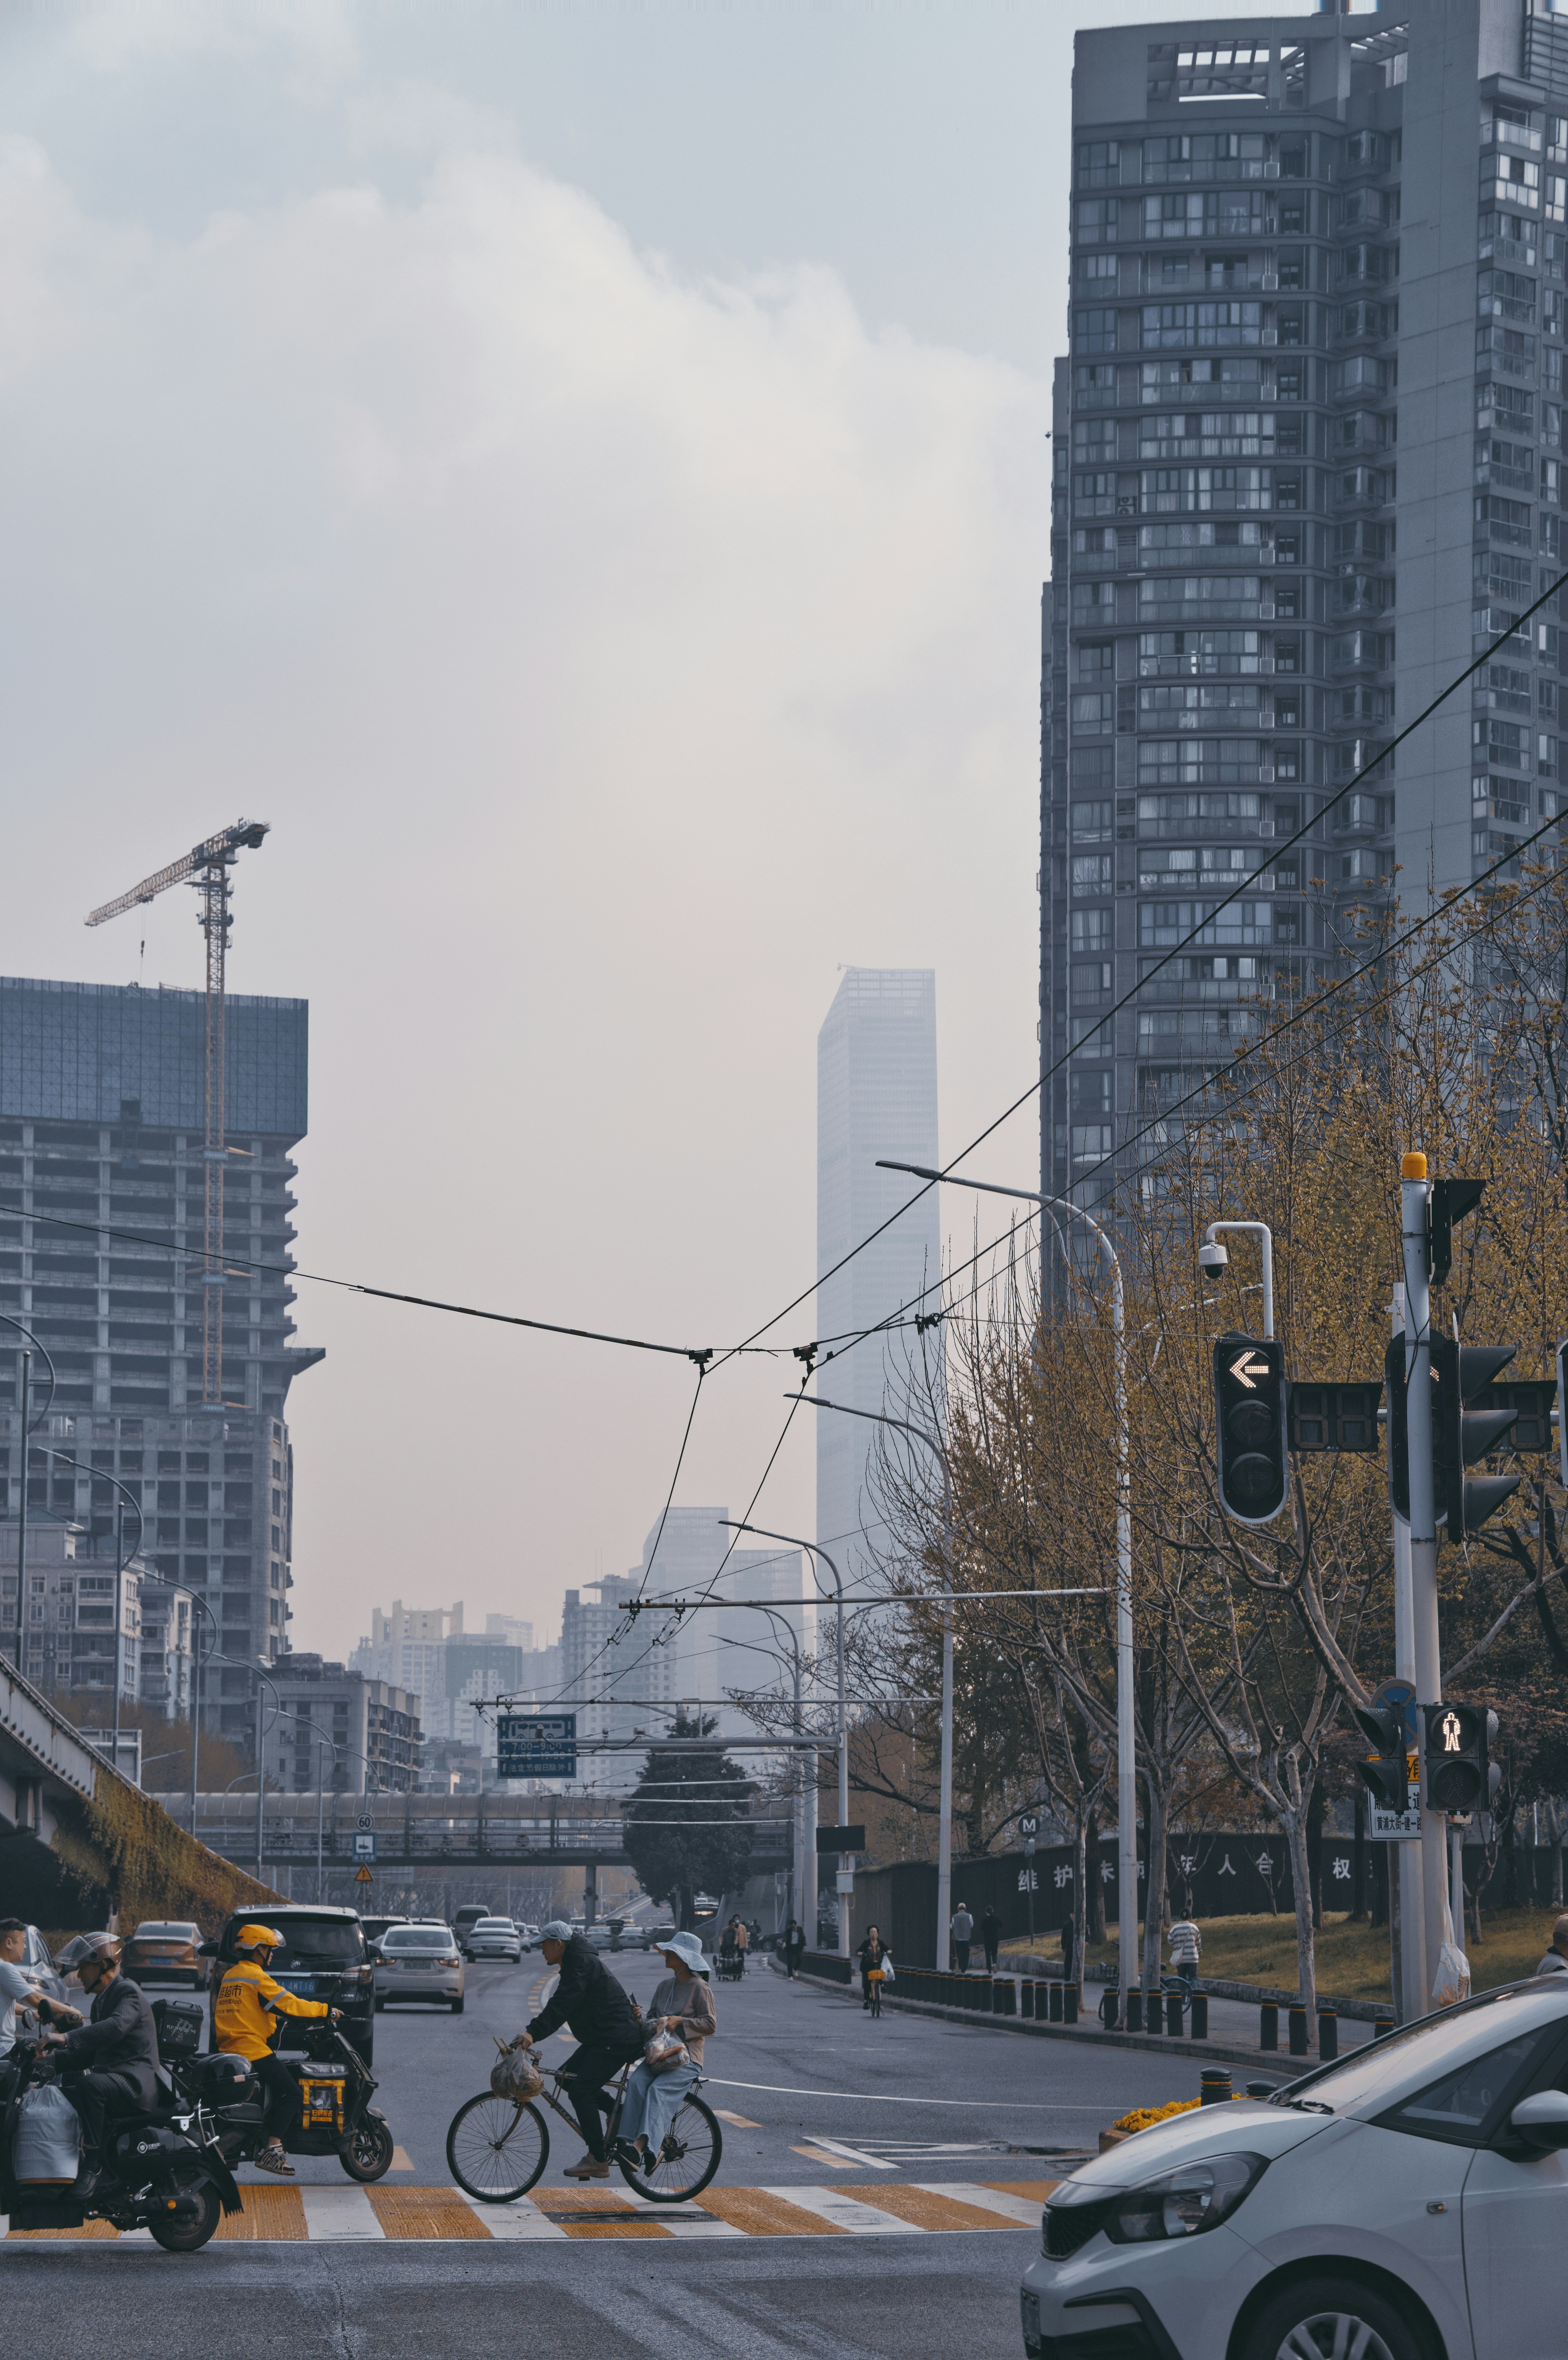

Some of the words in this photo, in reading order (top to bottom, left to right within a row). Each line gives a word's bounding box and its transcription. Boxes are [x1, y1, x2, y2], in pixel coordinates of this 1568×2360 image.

[509, 1763, 566, 1772] 法定节假日除外
[359, 1817, 371, 1828] 60
